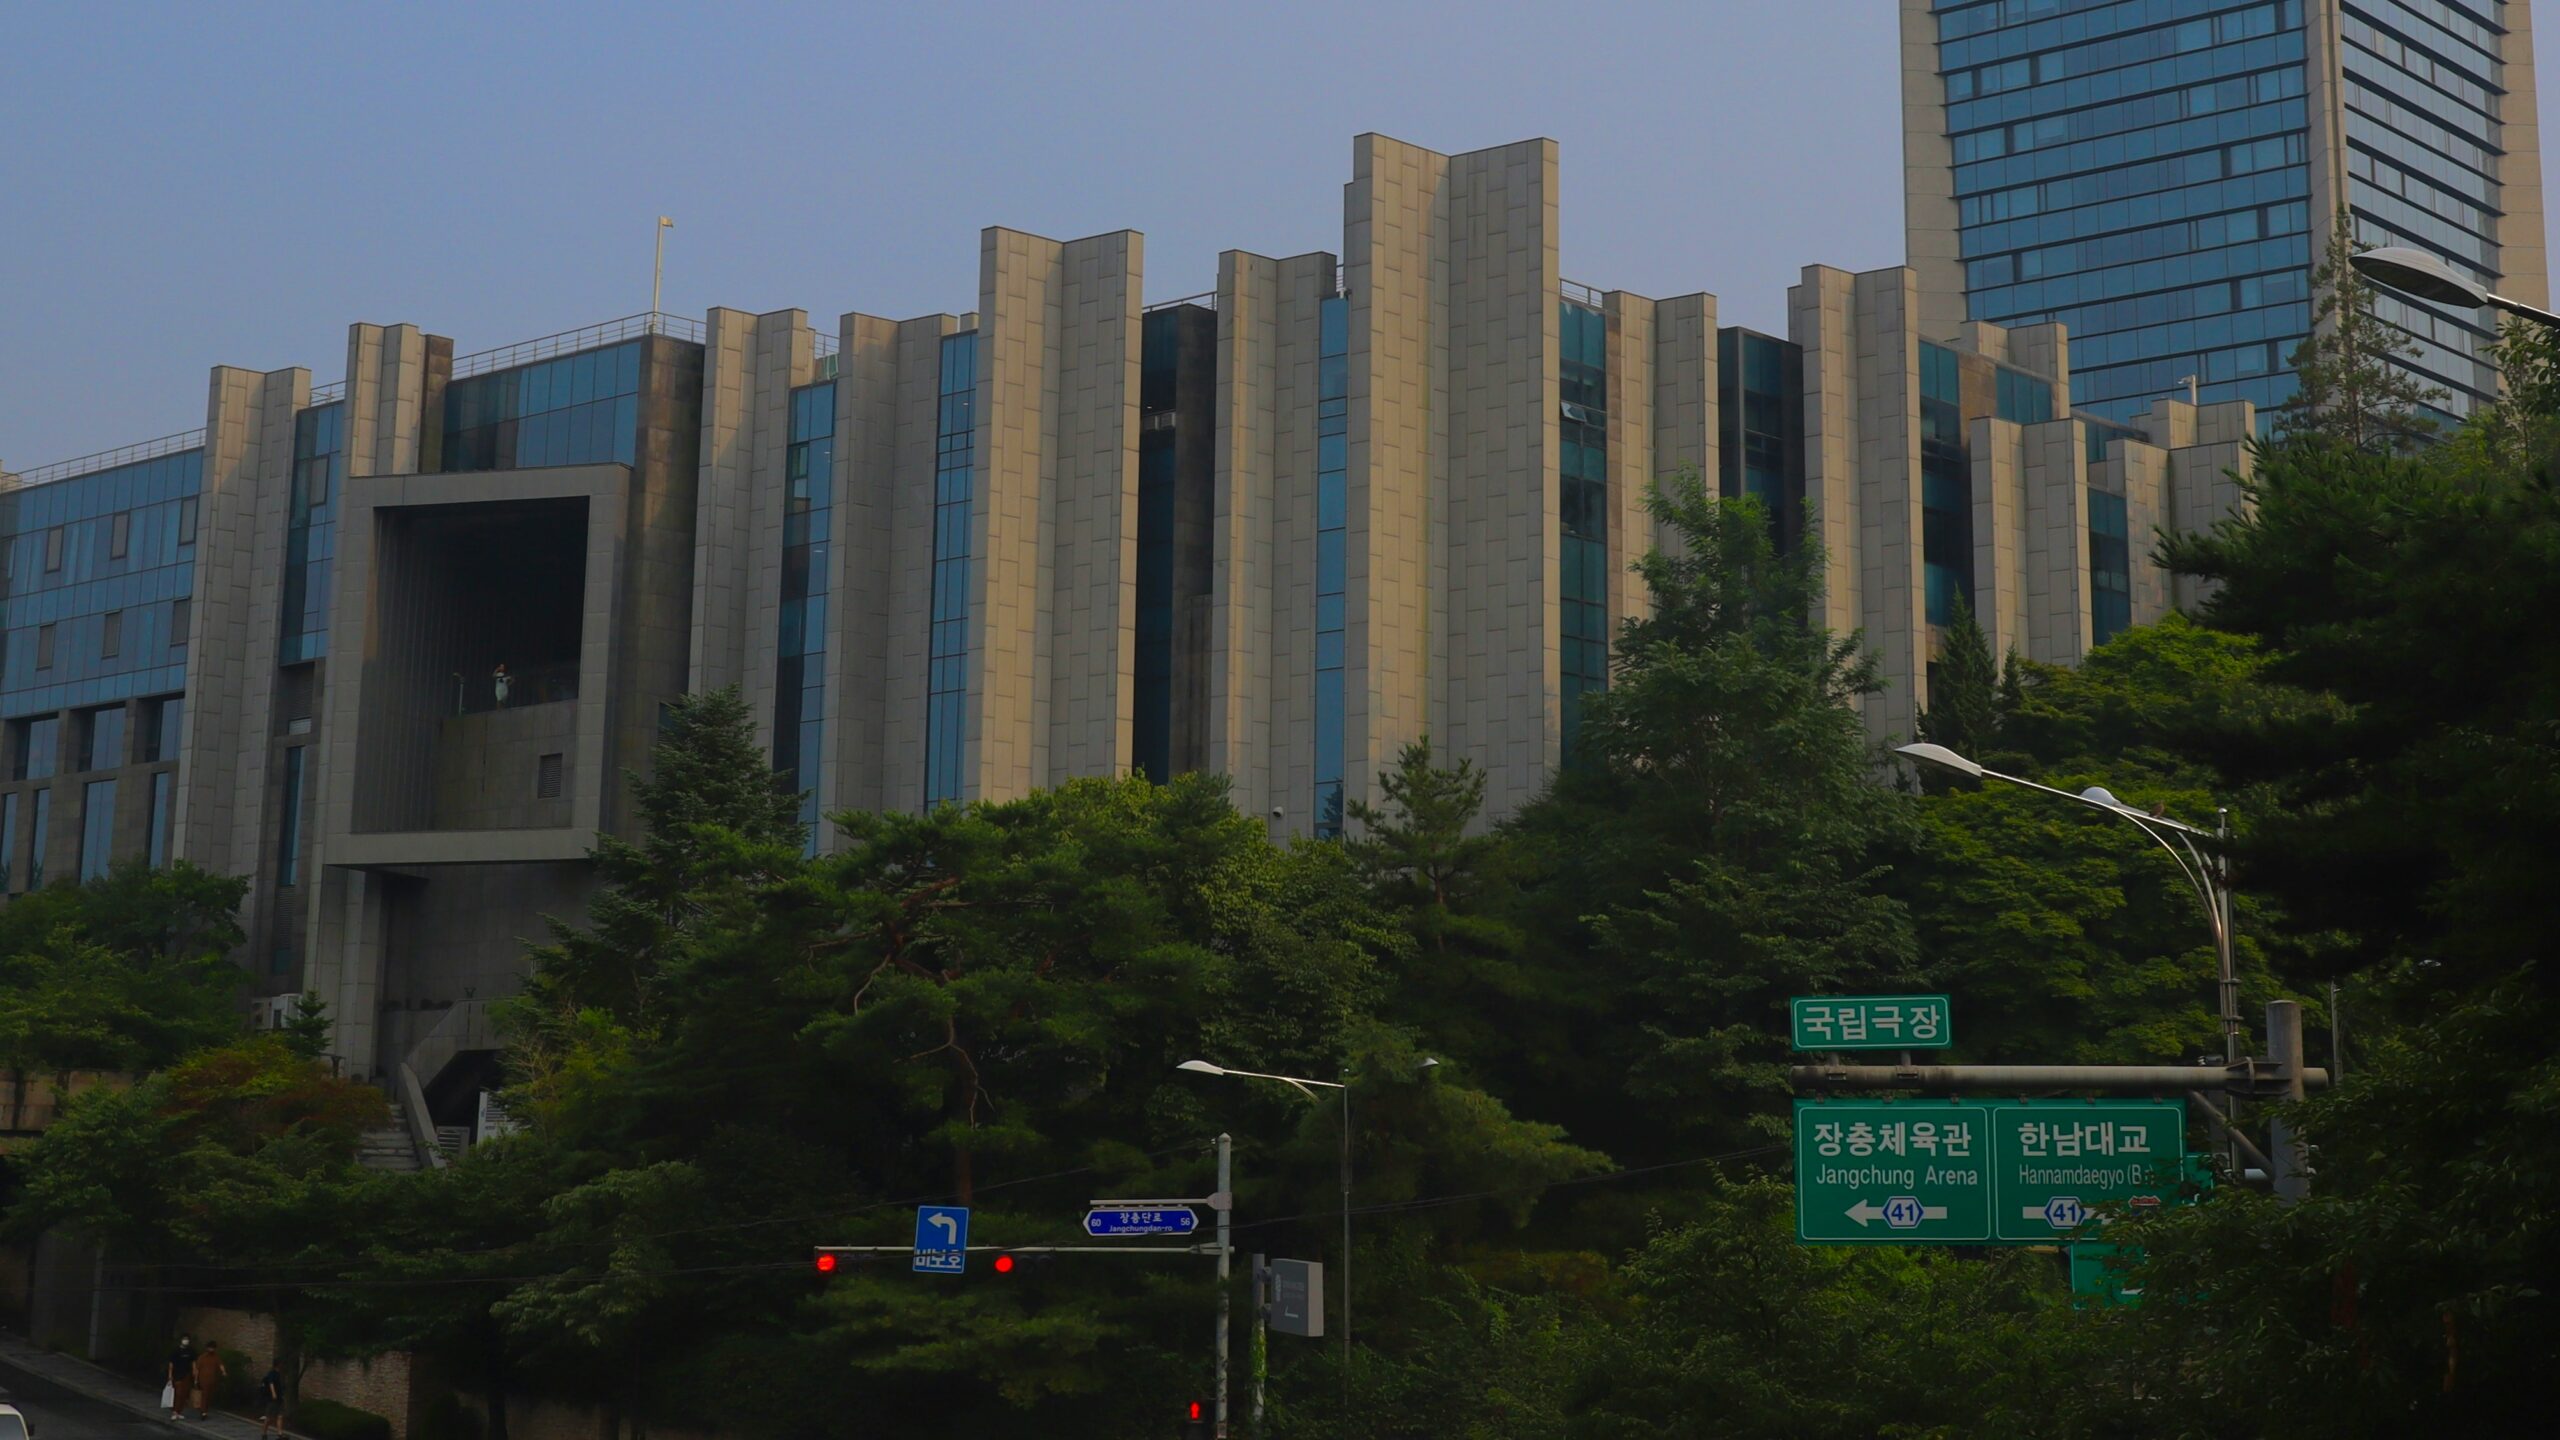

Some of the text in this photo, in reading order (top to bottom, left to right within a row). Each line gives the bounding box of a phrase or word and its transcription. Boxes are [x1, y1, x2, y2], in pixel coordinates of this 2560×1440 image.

[1803, 1004, 1941, 1041] 국립극장
[1813, 1121, 1972, 1157] 장충체육관
[2017, 1121, 2151, 1157] 한남대교
[1816, 1163, 1978, 1190] Jangchung Arena
[2019, 1164, 2124, 1190] Hannamdaegyo
[1119, 1212, 1163, 1224] 장충단로
[1180, 1217, 1191, 1227] 56
[1891, 1203, 1915, 1222] 41
[2053, 1203, 2076, 1222] 41
[1108, 1224, 1174, 1233] Jangchungdan-ro
[915, 1248, 962, 1270] 비보호
